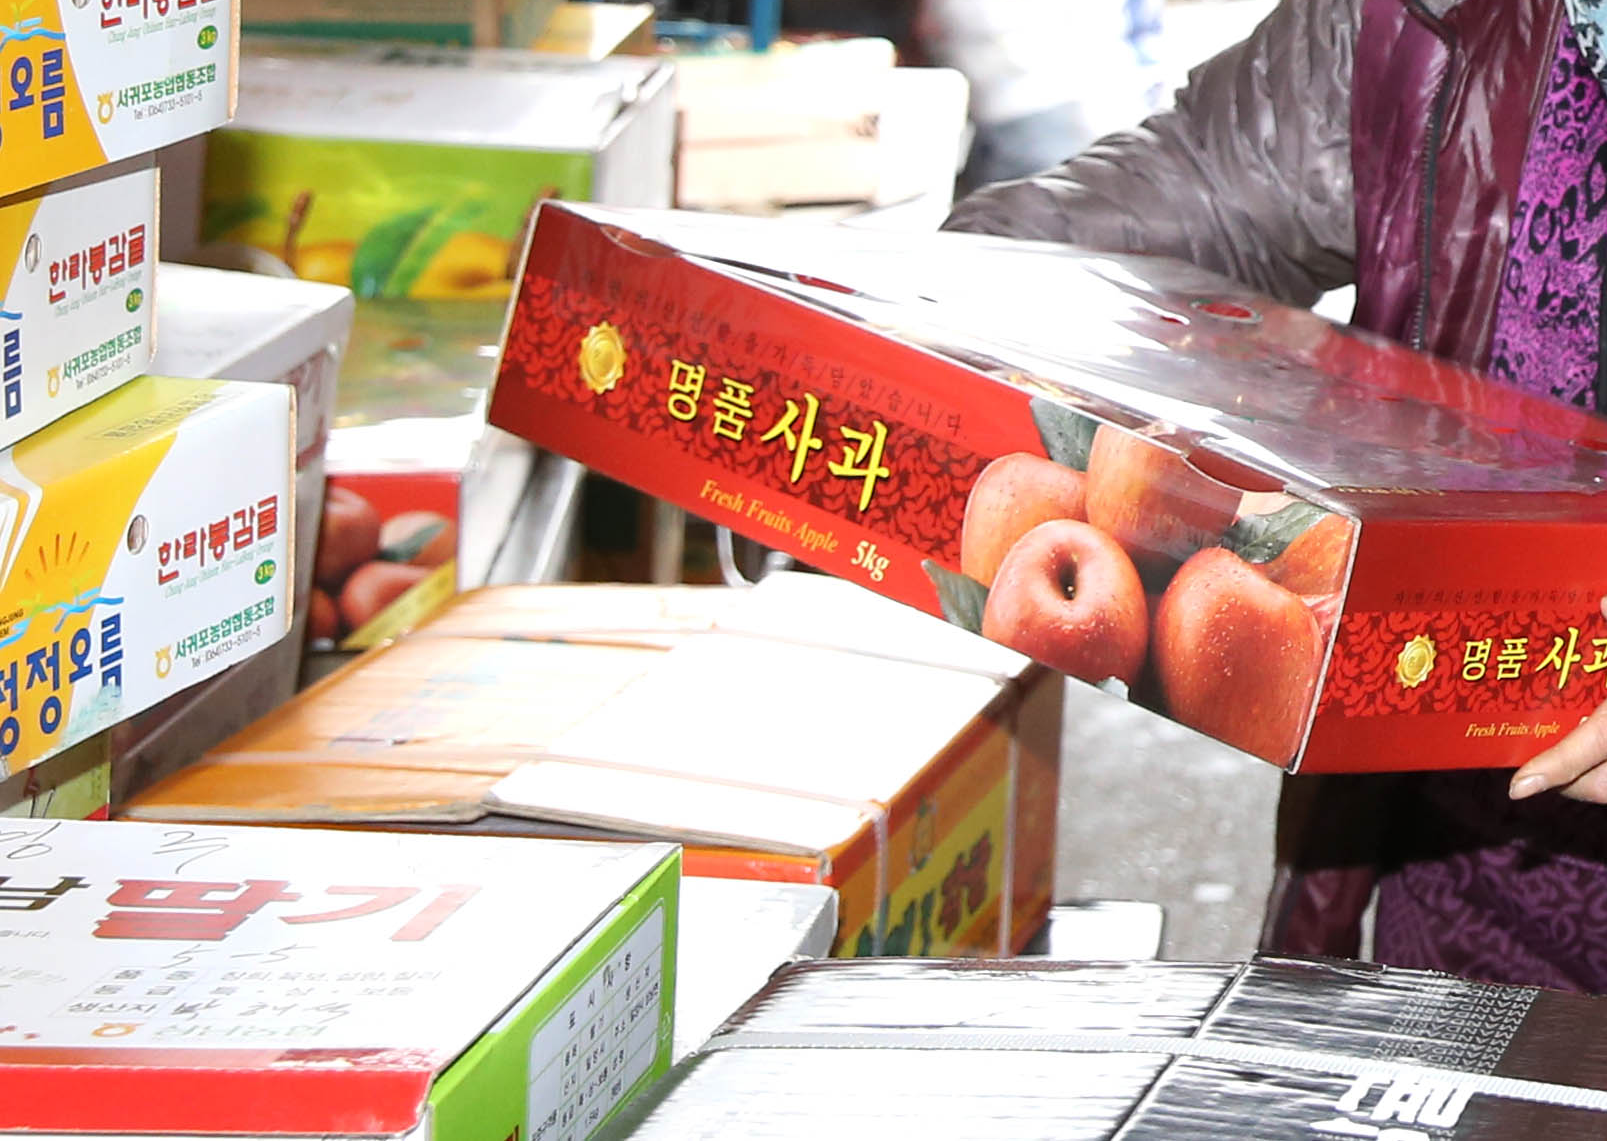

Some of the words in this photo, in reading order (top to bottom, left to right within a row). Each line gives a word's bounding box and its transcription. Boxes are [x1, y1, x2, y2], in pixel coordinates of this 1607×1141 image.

[49, 224, 145, 305] 한라봉감귤
[667, 358, 757, 441] 명품
[760, 391, 891, 514] 사과
[158, 495, 278, 586] 한라봉감귤
[699, 478, 744, 514] Fresh
[746, 499, 794, 536] Fruits
[794, 520, 839, 556] Apple
[850, 539, 891, 582] 5kg
[175, 596, 275, 659] 서귀포농업협동조합
[1462, 636, 1529, 682] 명품
[1465, 723, 1496, 738] Fresh
[1498, 723, 1530, 738] Fruits
[1529, 722, 1561, 738] Apple
